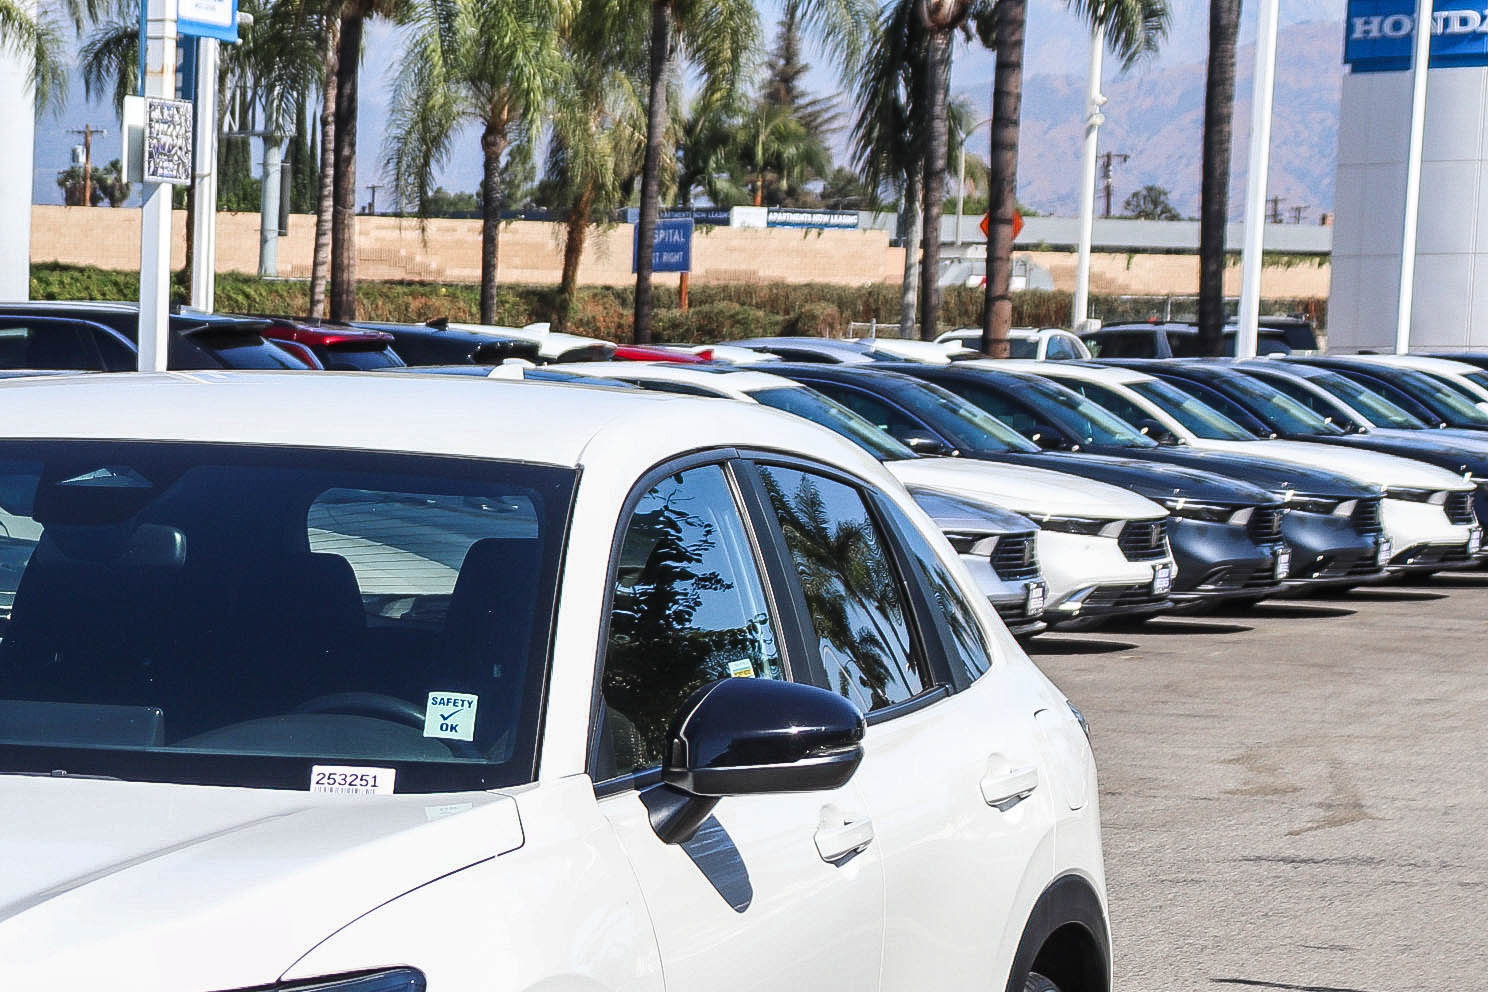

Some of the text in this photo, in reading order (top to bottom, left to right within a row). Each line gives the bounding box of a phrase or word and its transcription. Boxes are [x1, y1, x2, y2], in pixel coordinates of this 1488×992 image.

[1352, 9, 1488, 39] HOND
[653, 229, 686, 242] SPITAL
[431, 696, 474, 709] SAFETY
[439, 722, 459, 733] OK
[315, 772, 379, 788] 253251
